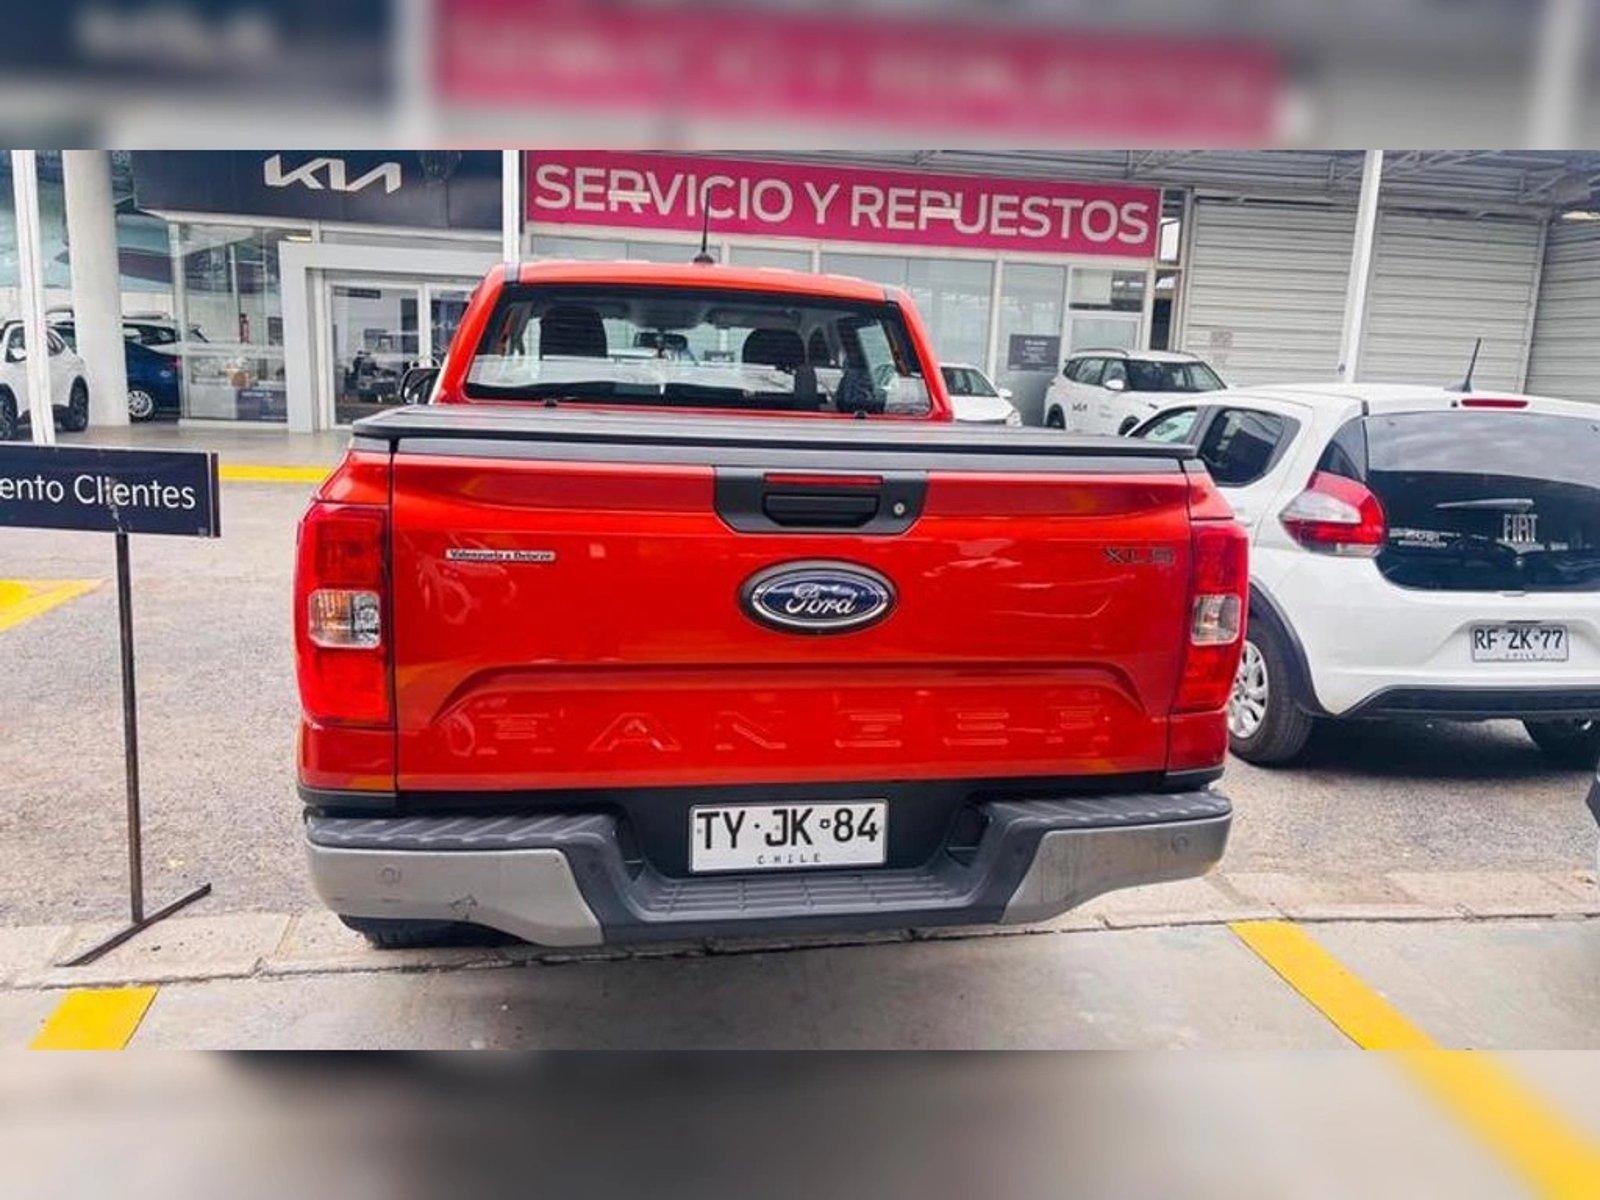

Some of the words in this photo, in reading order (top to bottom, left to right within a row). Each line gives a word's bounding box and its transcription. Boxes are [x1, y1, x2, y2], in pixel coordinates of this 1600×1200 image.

[263, 152, 402, 194] KIA
[534, 163, 794, 223] SERVICIO
[803, 181, 840, 226] Y
[851, 184, 1150, 245] REPUESTOS
[73, 474, 197, 510] Clientes
[1503, 514, 1539, 543] FIAT
[785, 582, 859, 614] Ford
[757, 853, 822, 865] CHILE
